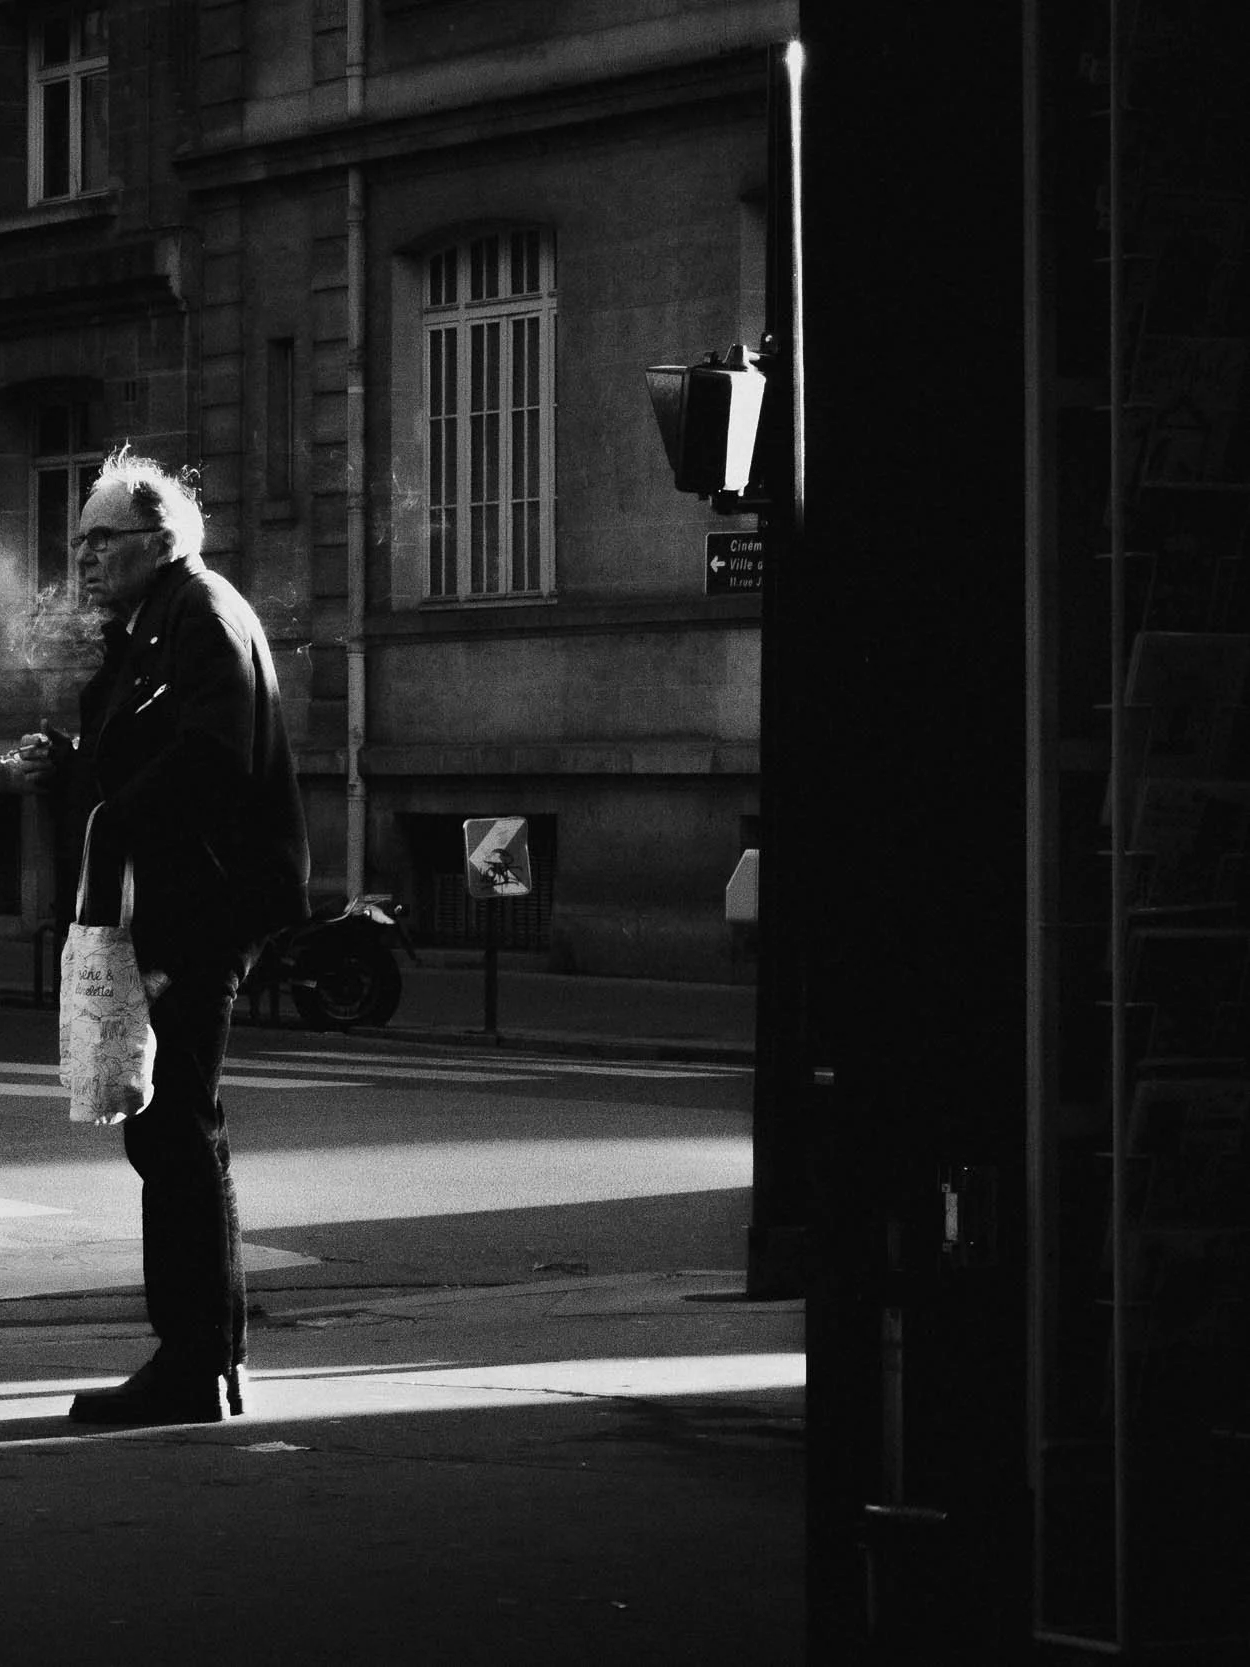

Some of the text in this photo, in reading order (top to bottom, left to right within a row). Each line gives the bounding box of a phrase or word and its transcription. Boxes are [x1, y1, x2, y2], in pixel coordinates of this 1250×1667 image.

[730, 557, 753, 571] Ville
[739, 579, 753, 587] rue
[106, 968, 114, 981] &
